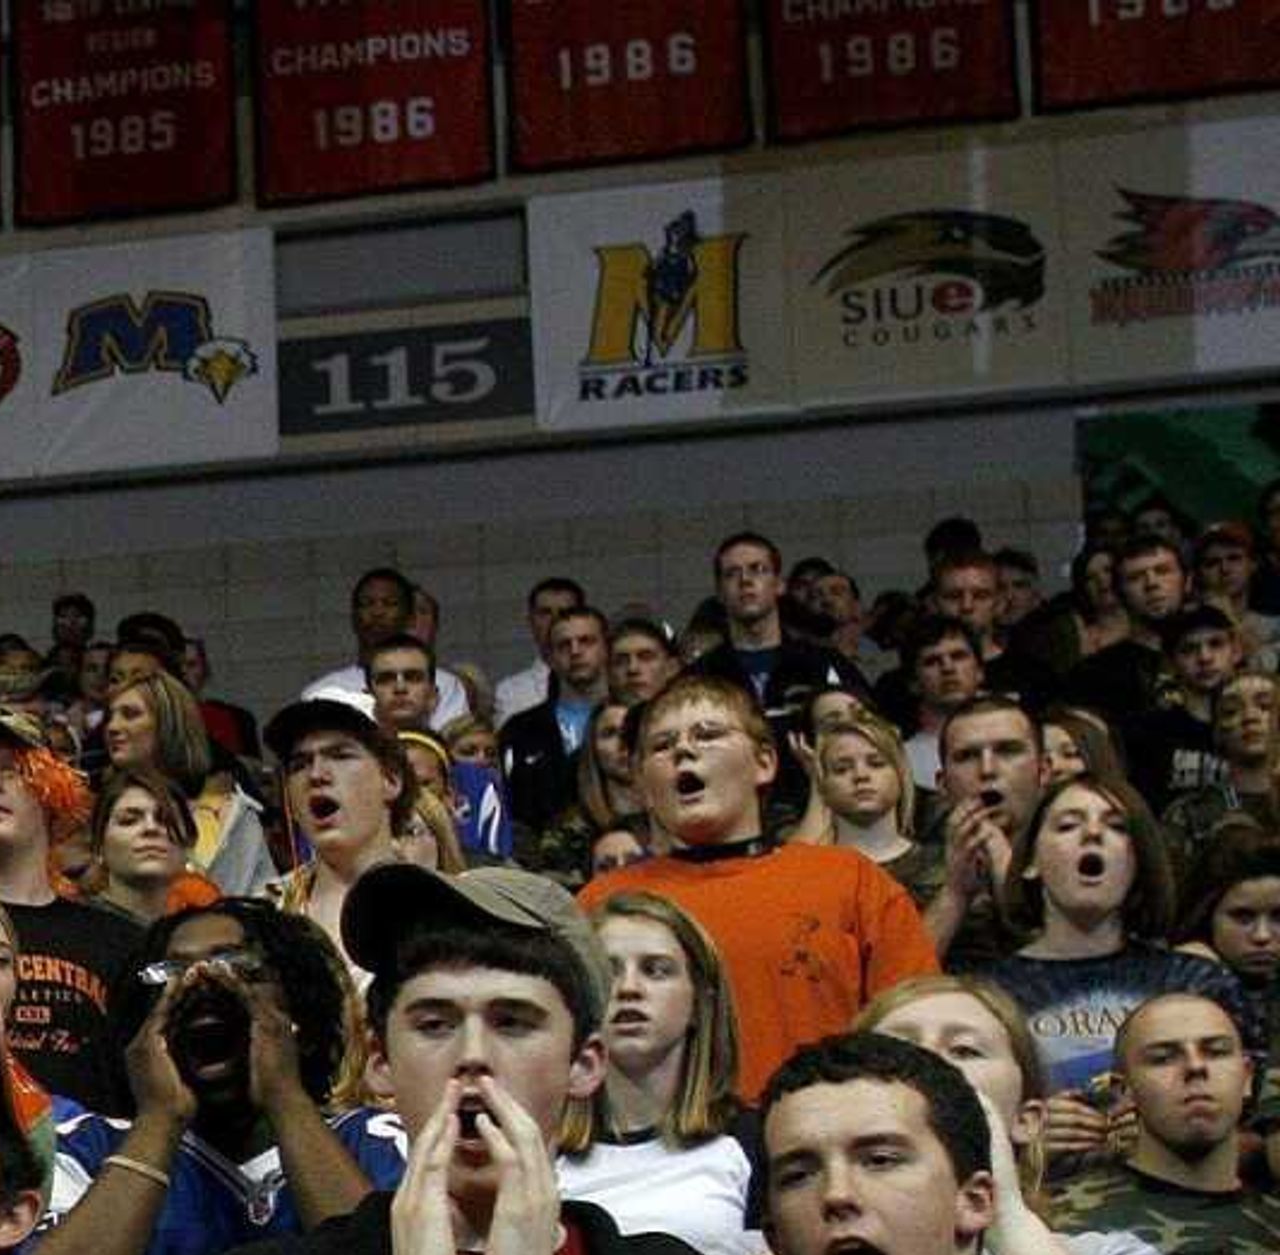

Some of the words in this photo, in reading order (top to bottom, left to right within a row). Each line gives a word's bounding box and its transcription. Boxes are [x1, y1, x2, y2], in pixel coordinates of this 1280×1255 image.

[269, 26, 472, 78] CHAMPIONS
[557, 32, 697, 91] 1986
[819, 27, 962, 85] 1986
[31, 60, 217, 109] CHAMPIONS
[69, 109, 179, 162] 1985
[314, 95, 436, 152] 1986
[842, 314, 1036, 348] COUGARS
[312, 336, 498, 417] 115
[579, 364, 748, 400] RACERS
